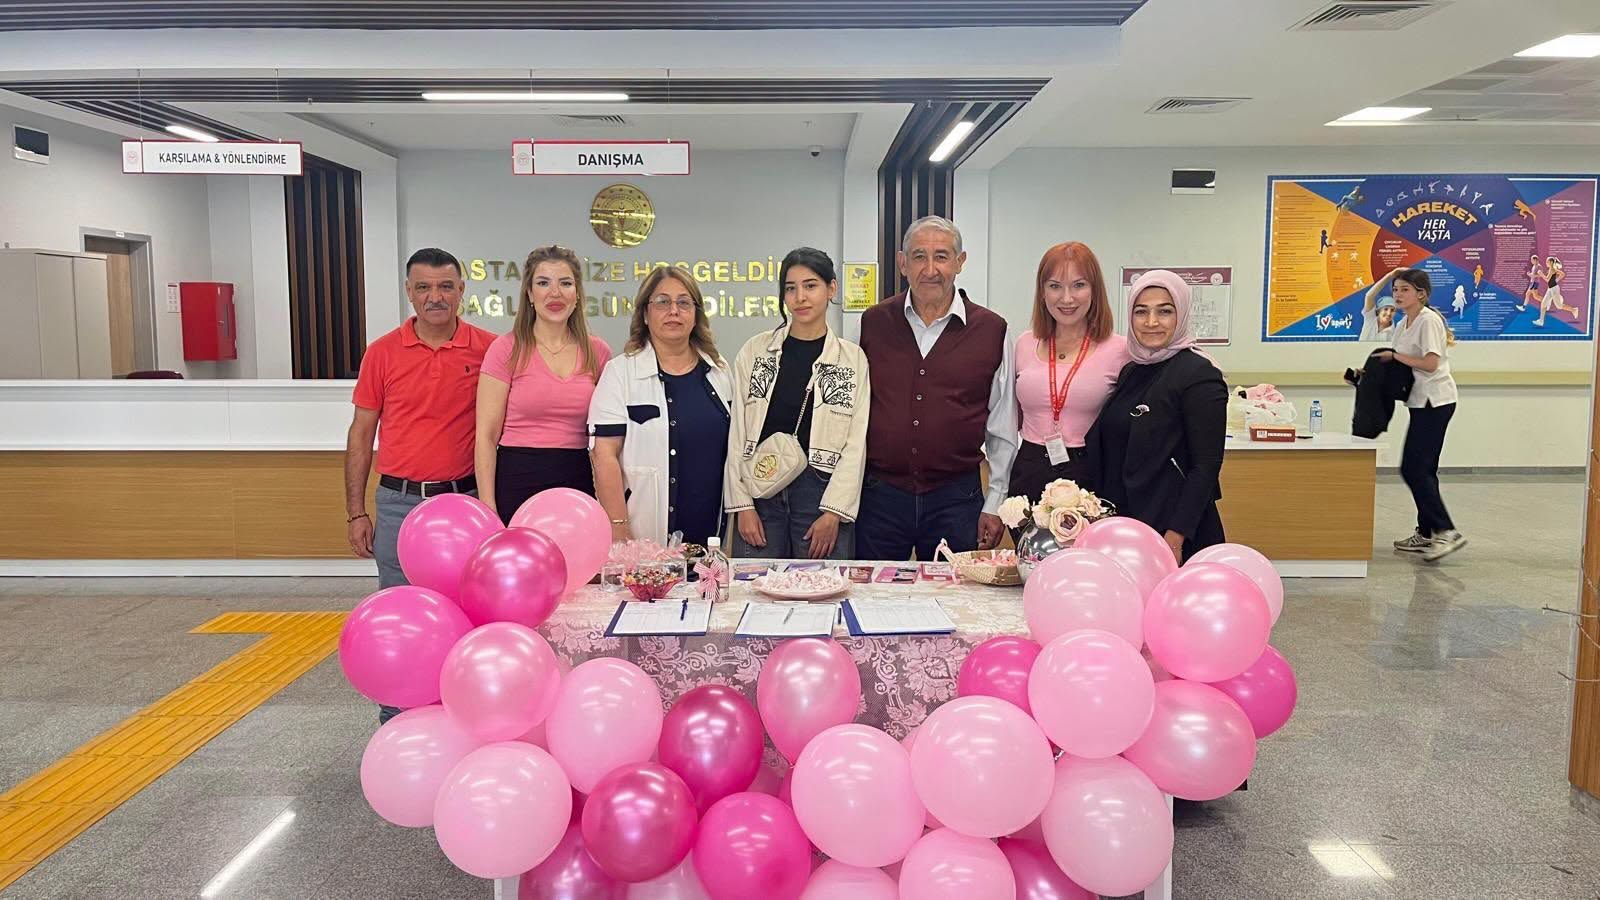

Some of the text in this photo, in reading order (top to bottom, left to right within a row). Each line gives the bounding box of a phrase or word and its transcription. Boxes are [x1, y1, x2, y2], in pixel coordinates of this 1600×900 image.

[159, 152, 287, 165] KARŞILAMA & YÖNLENDİRME
[578, 153, 644, 168] DANIŞMA
[1391, 201, 1478, 228] HAREKET
[1423, 218, 1447, 230] HER
[1417, 229, 1451, 243] YAŞTA
